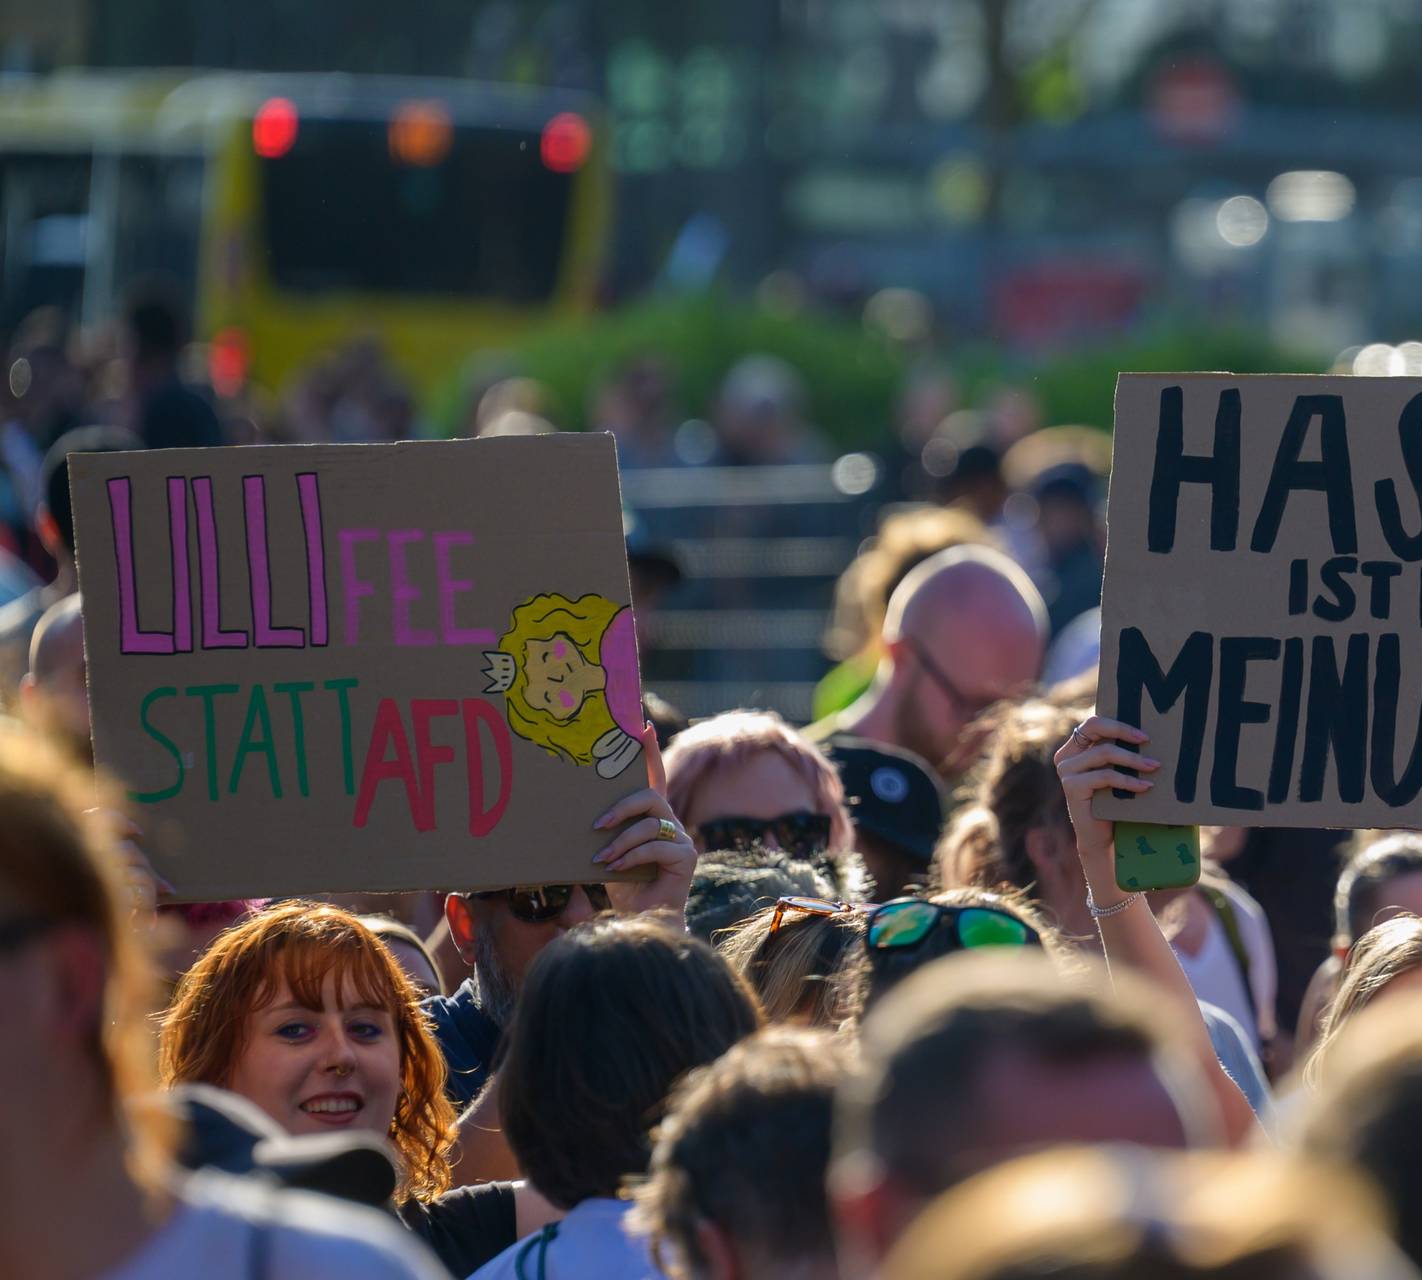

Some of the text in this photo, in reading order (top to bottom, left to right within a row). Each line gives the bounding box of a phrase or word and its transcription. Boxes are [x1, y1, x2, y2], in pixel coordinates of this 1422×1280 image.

[1288, 556, 1402, 622] IST
[128, 678, 514, 838] STATT AFD
